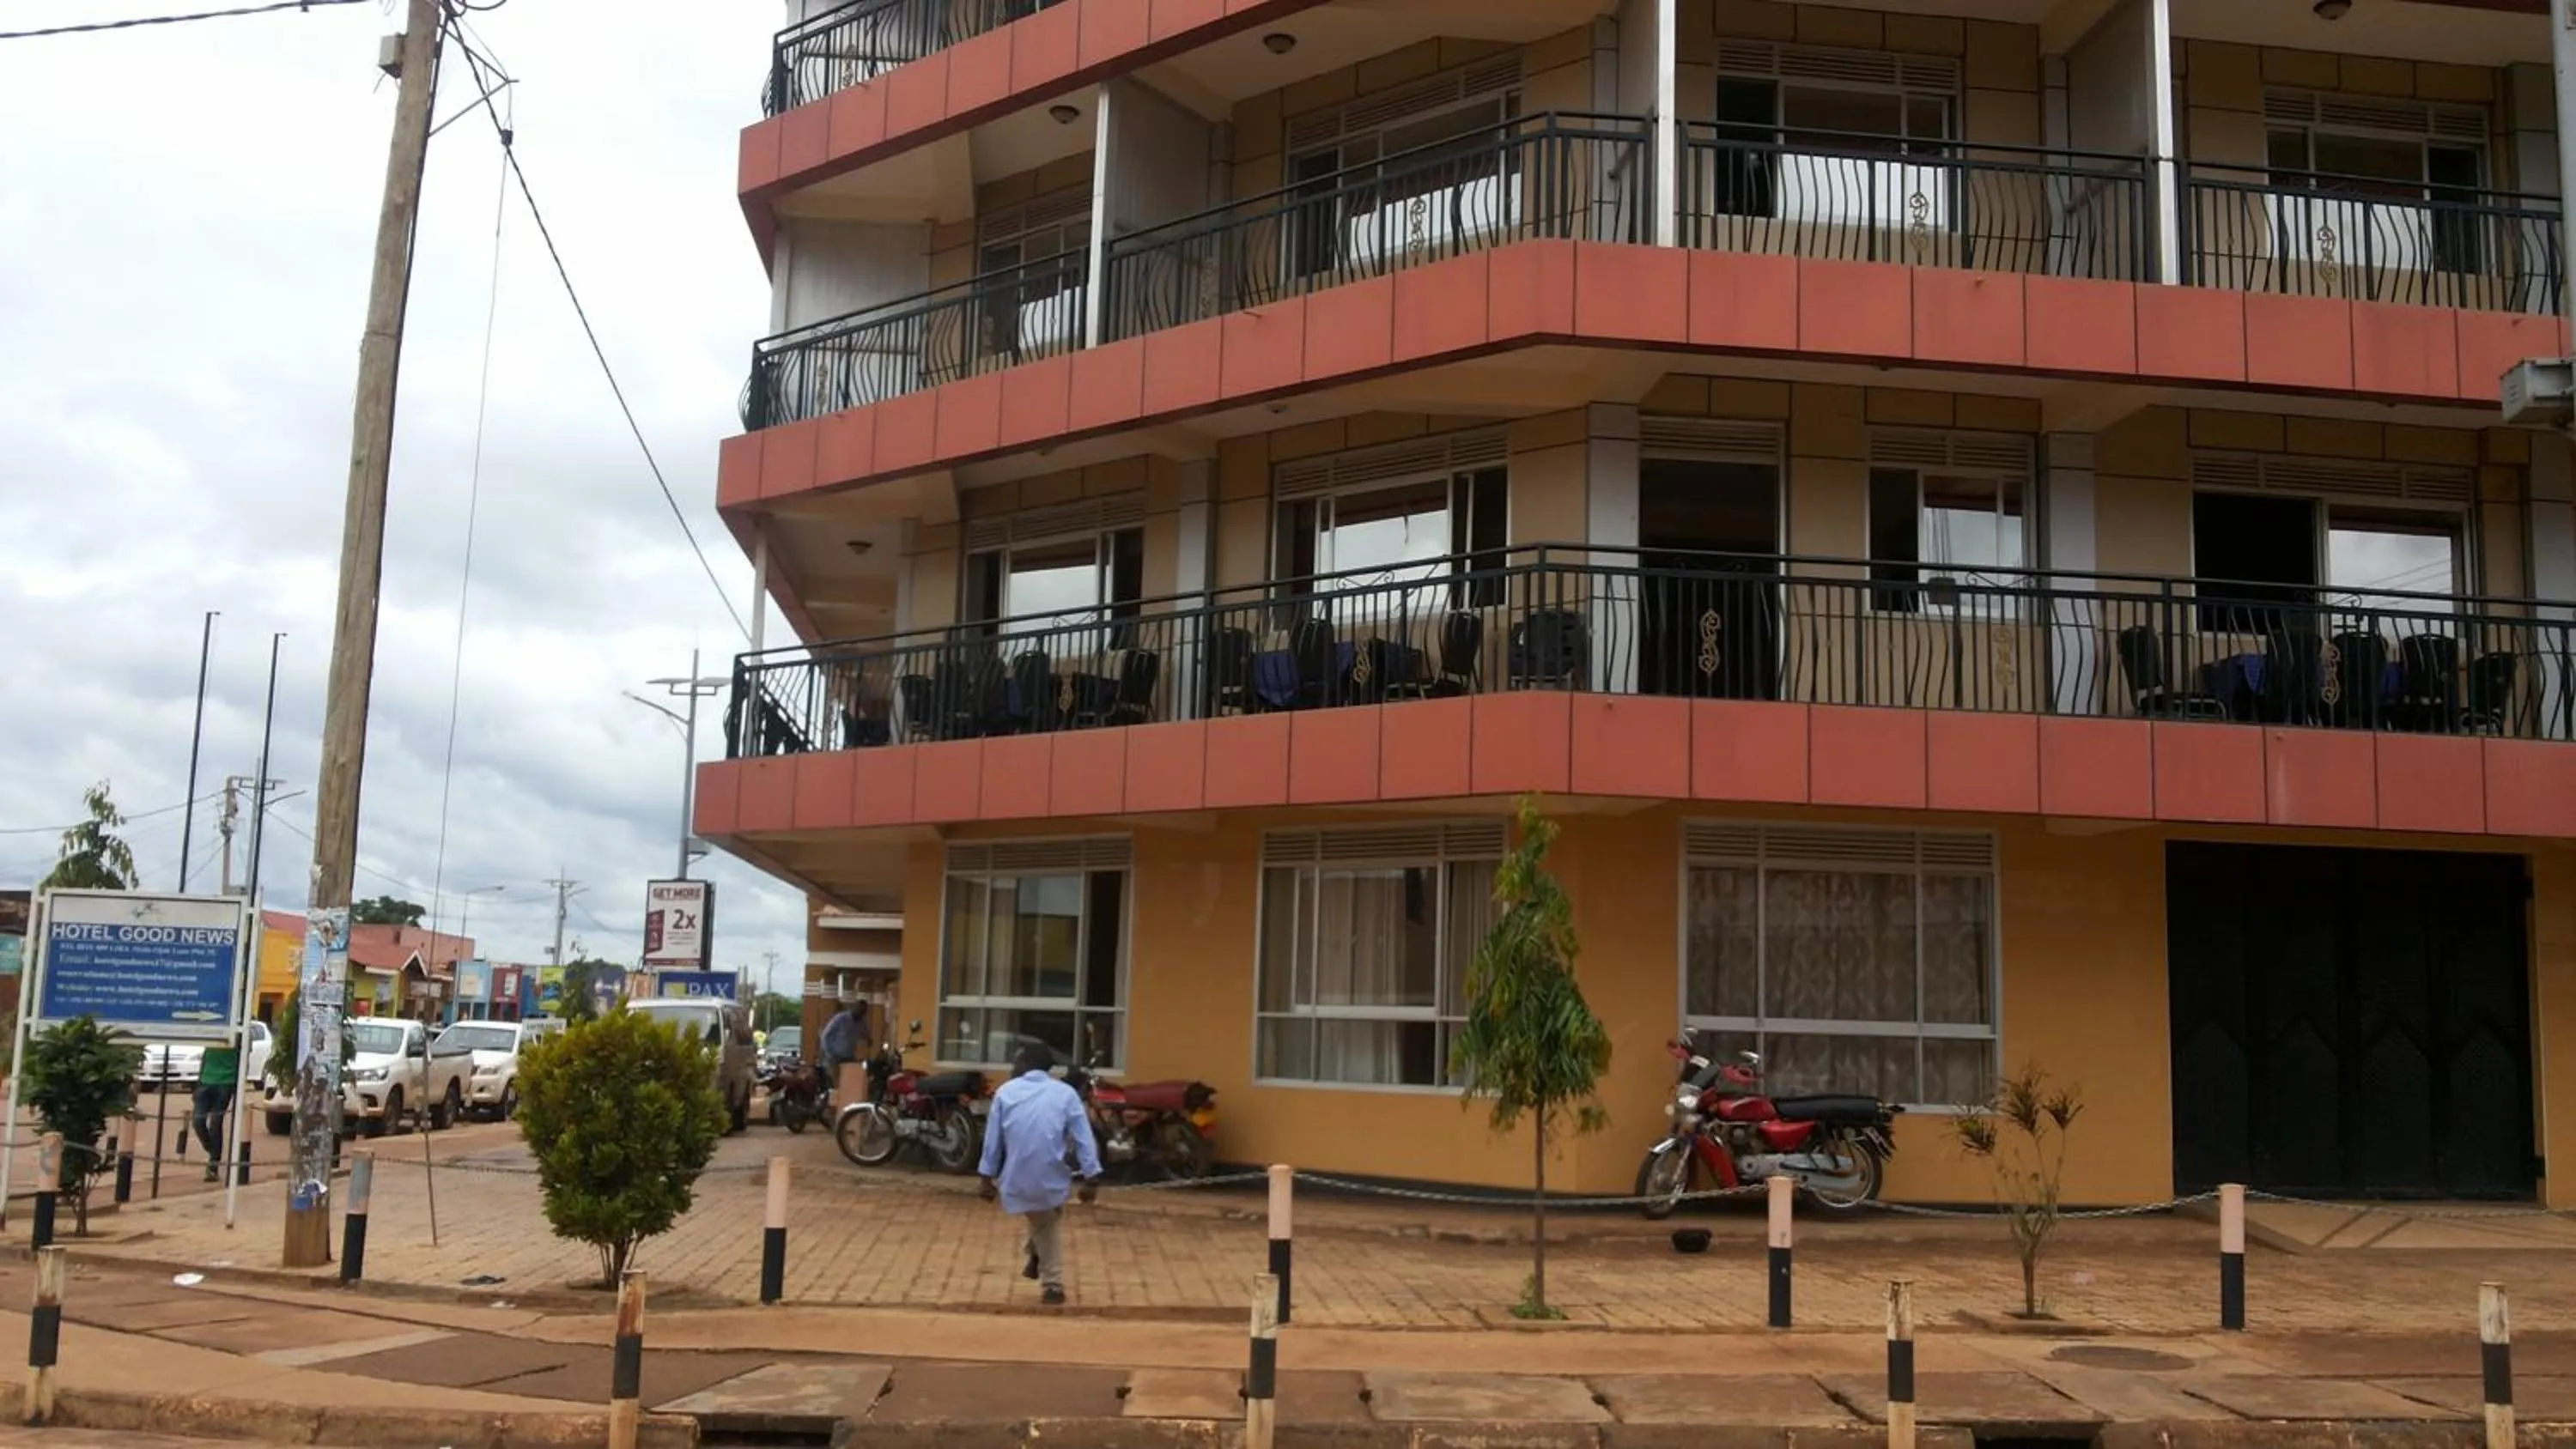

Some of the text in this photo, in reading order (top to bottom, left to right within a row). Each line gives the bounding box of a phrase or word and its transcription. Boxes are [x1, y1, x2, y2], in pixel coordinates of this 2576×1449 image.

[52, 924, 234, 945] HOTEL GOOD NEWS
[688, 982, 730, 1000] PAX
